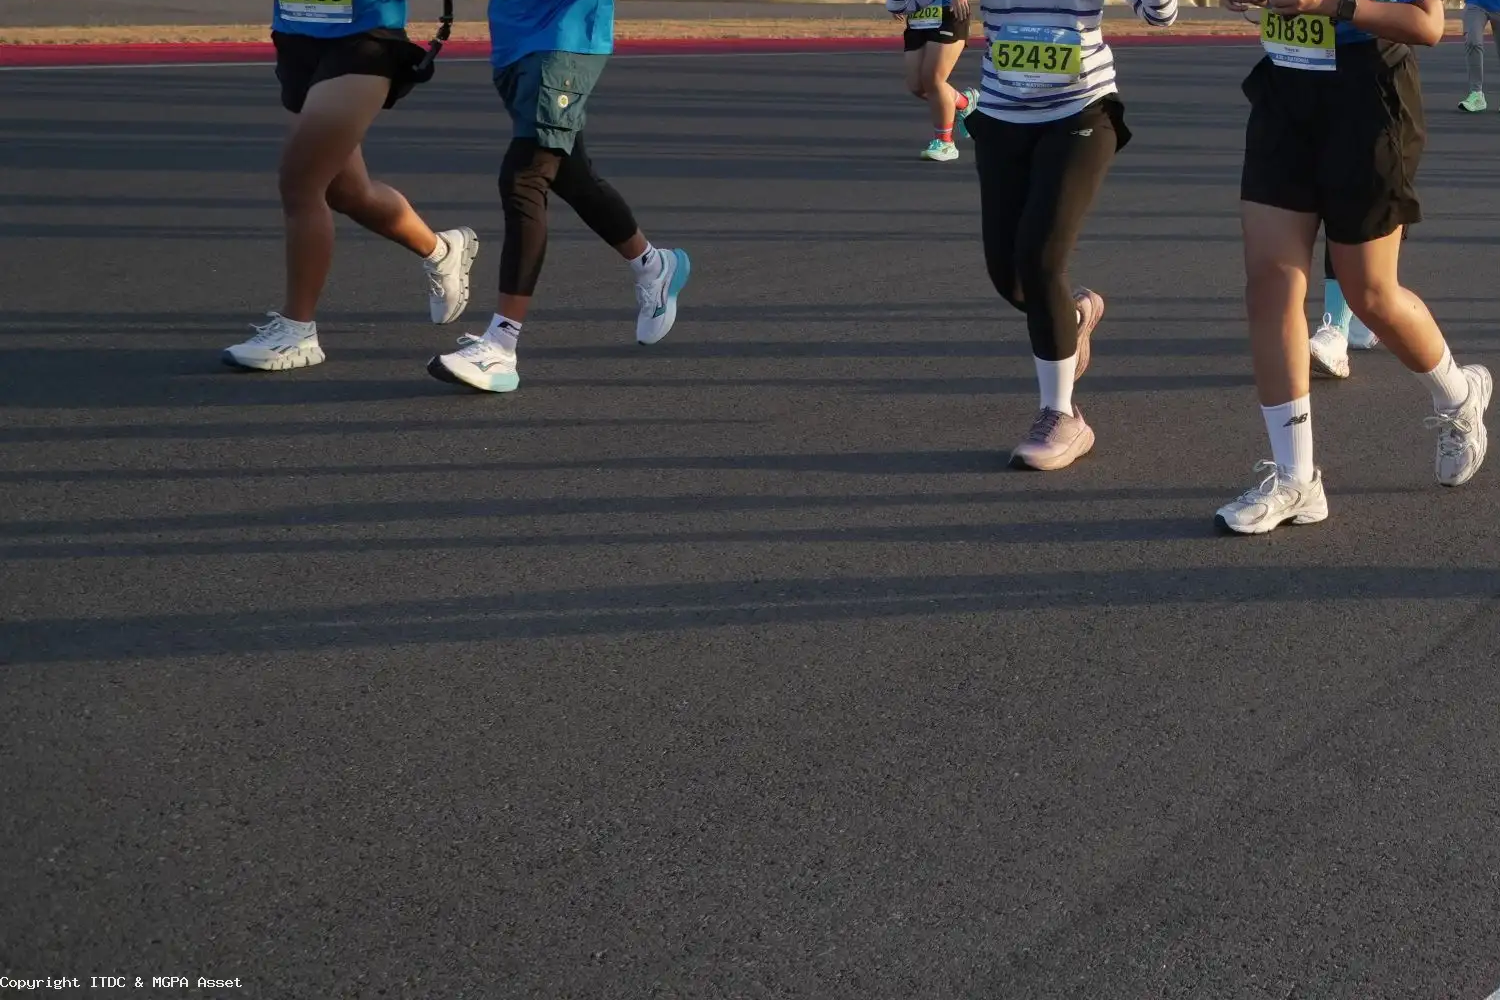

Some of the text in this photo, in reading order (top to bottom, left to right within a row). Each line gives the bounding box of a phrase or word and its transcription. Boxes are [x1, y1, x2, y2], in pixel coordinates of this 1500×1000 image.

[908, 6, 939, 19] 2202
[1266, 12, 1323, 45] 51839
[998, 43, 1073, 71] 52437
